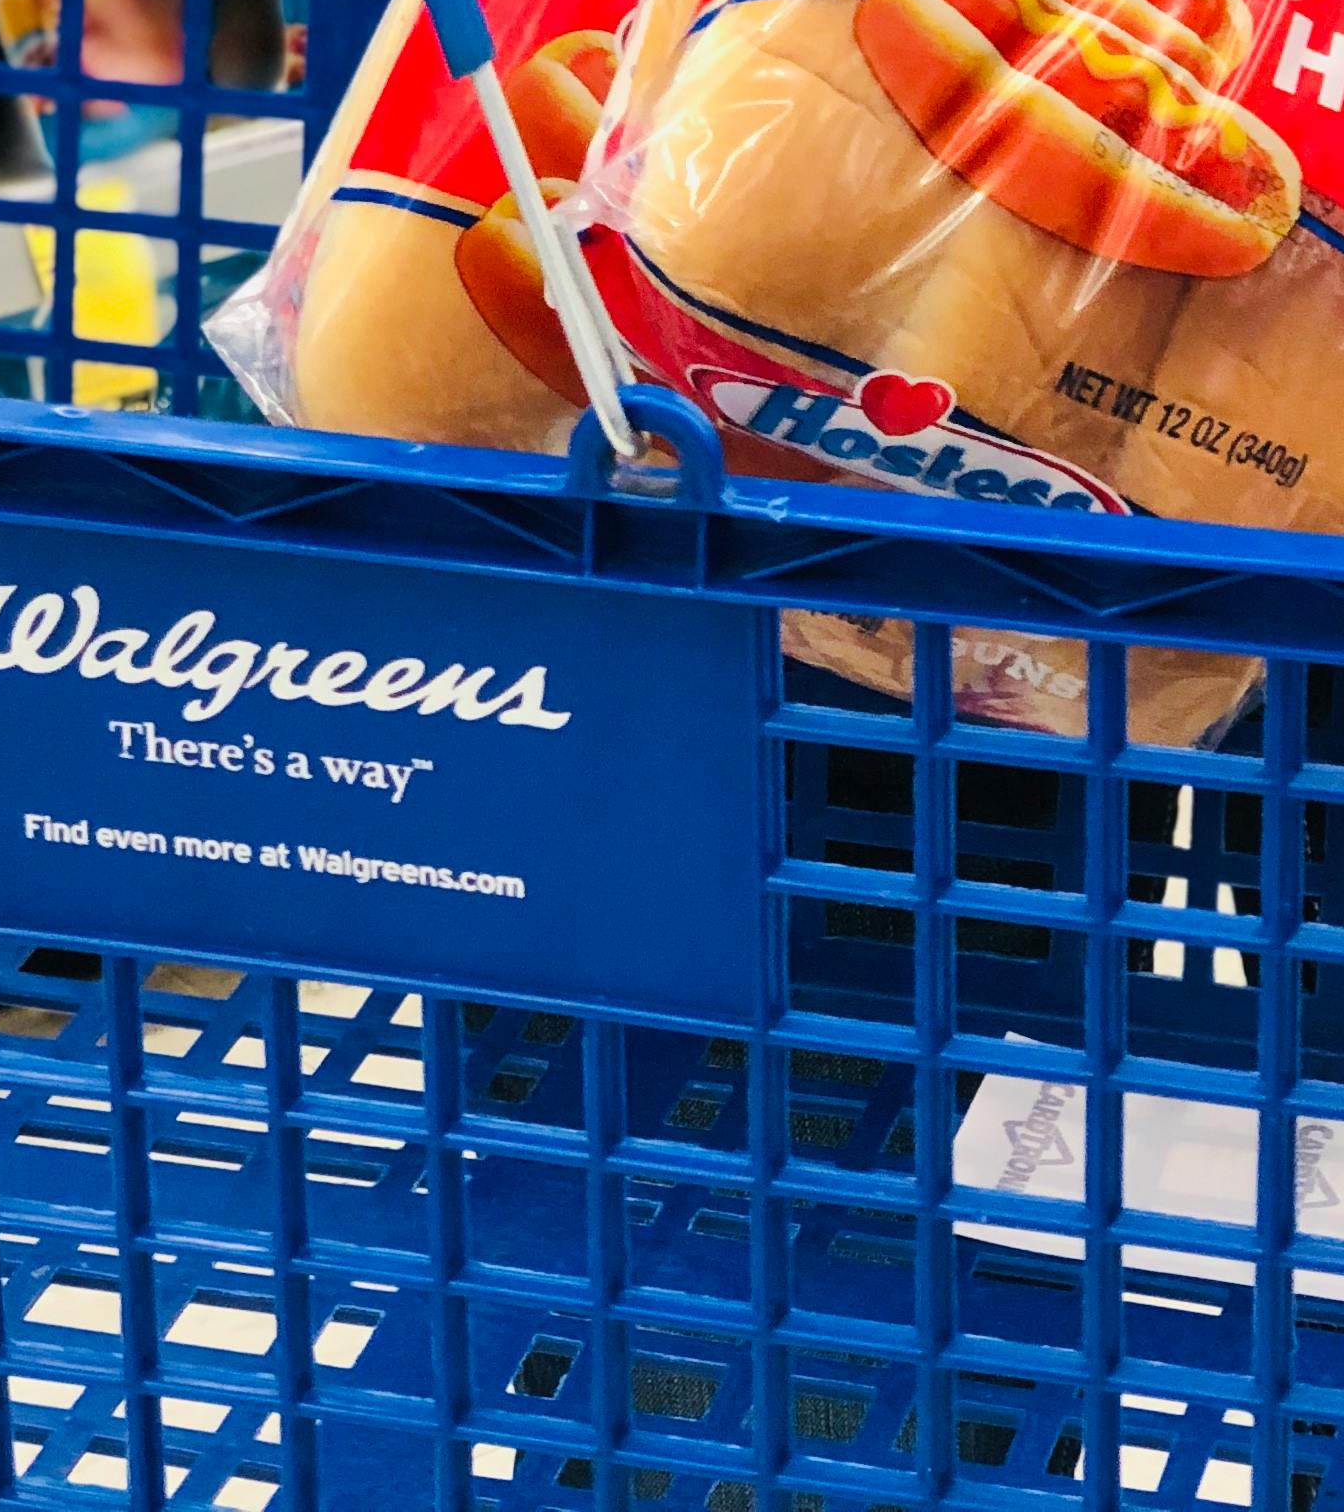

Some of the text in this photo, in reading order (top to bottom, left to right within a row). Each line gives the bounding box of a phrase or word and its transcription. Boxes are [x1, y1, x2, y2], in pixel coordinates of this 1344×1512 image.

[1056, 361, 1309, 488] NET WT 12 OZ (340g)
[108, 719, 275, 775] There's
[286, 752, 313, 779] a
[24, 812, 526, 899] Find even more at Walgreens.com
